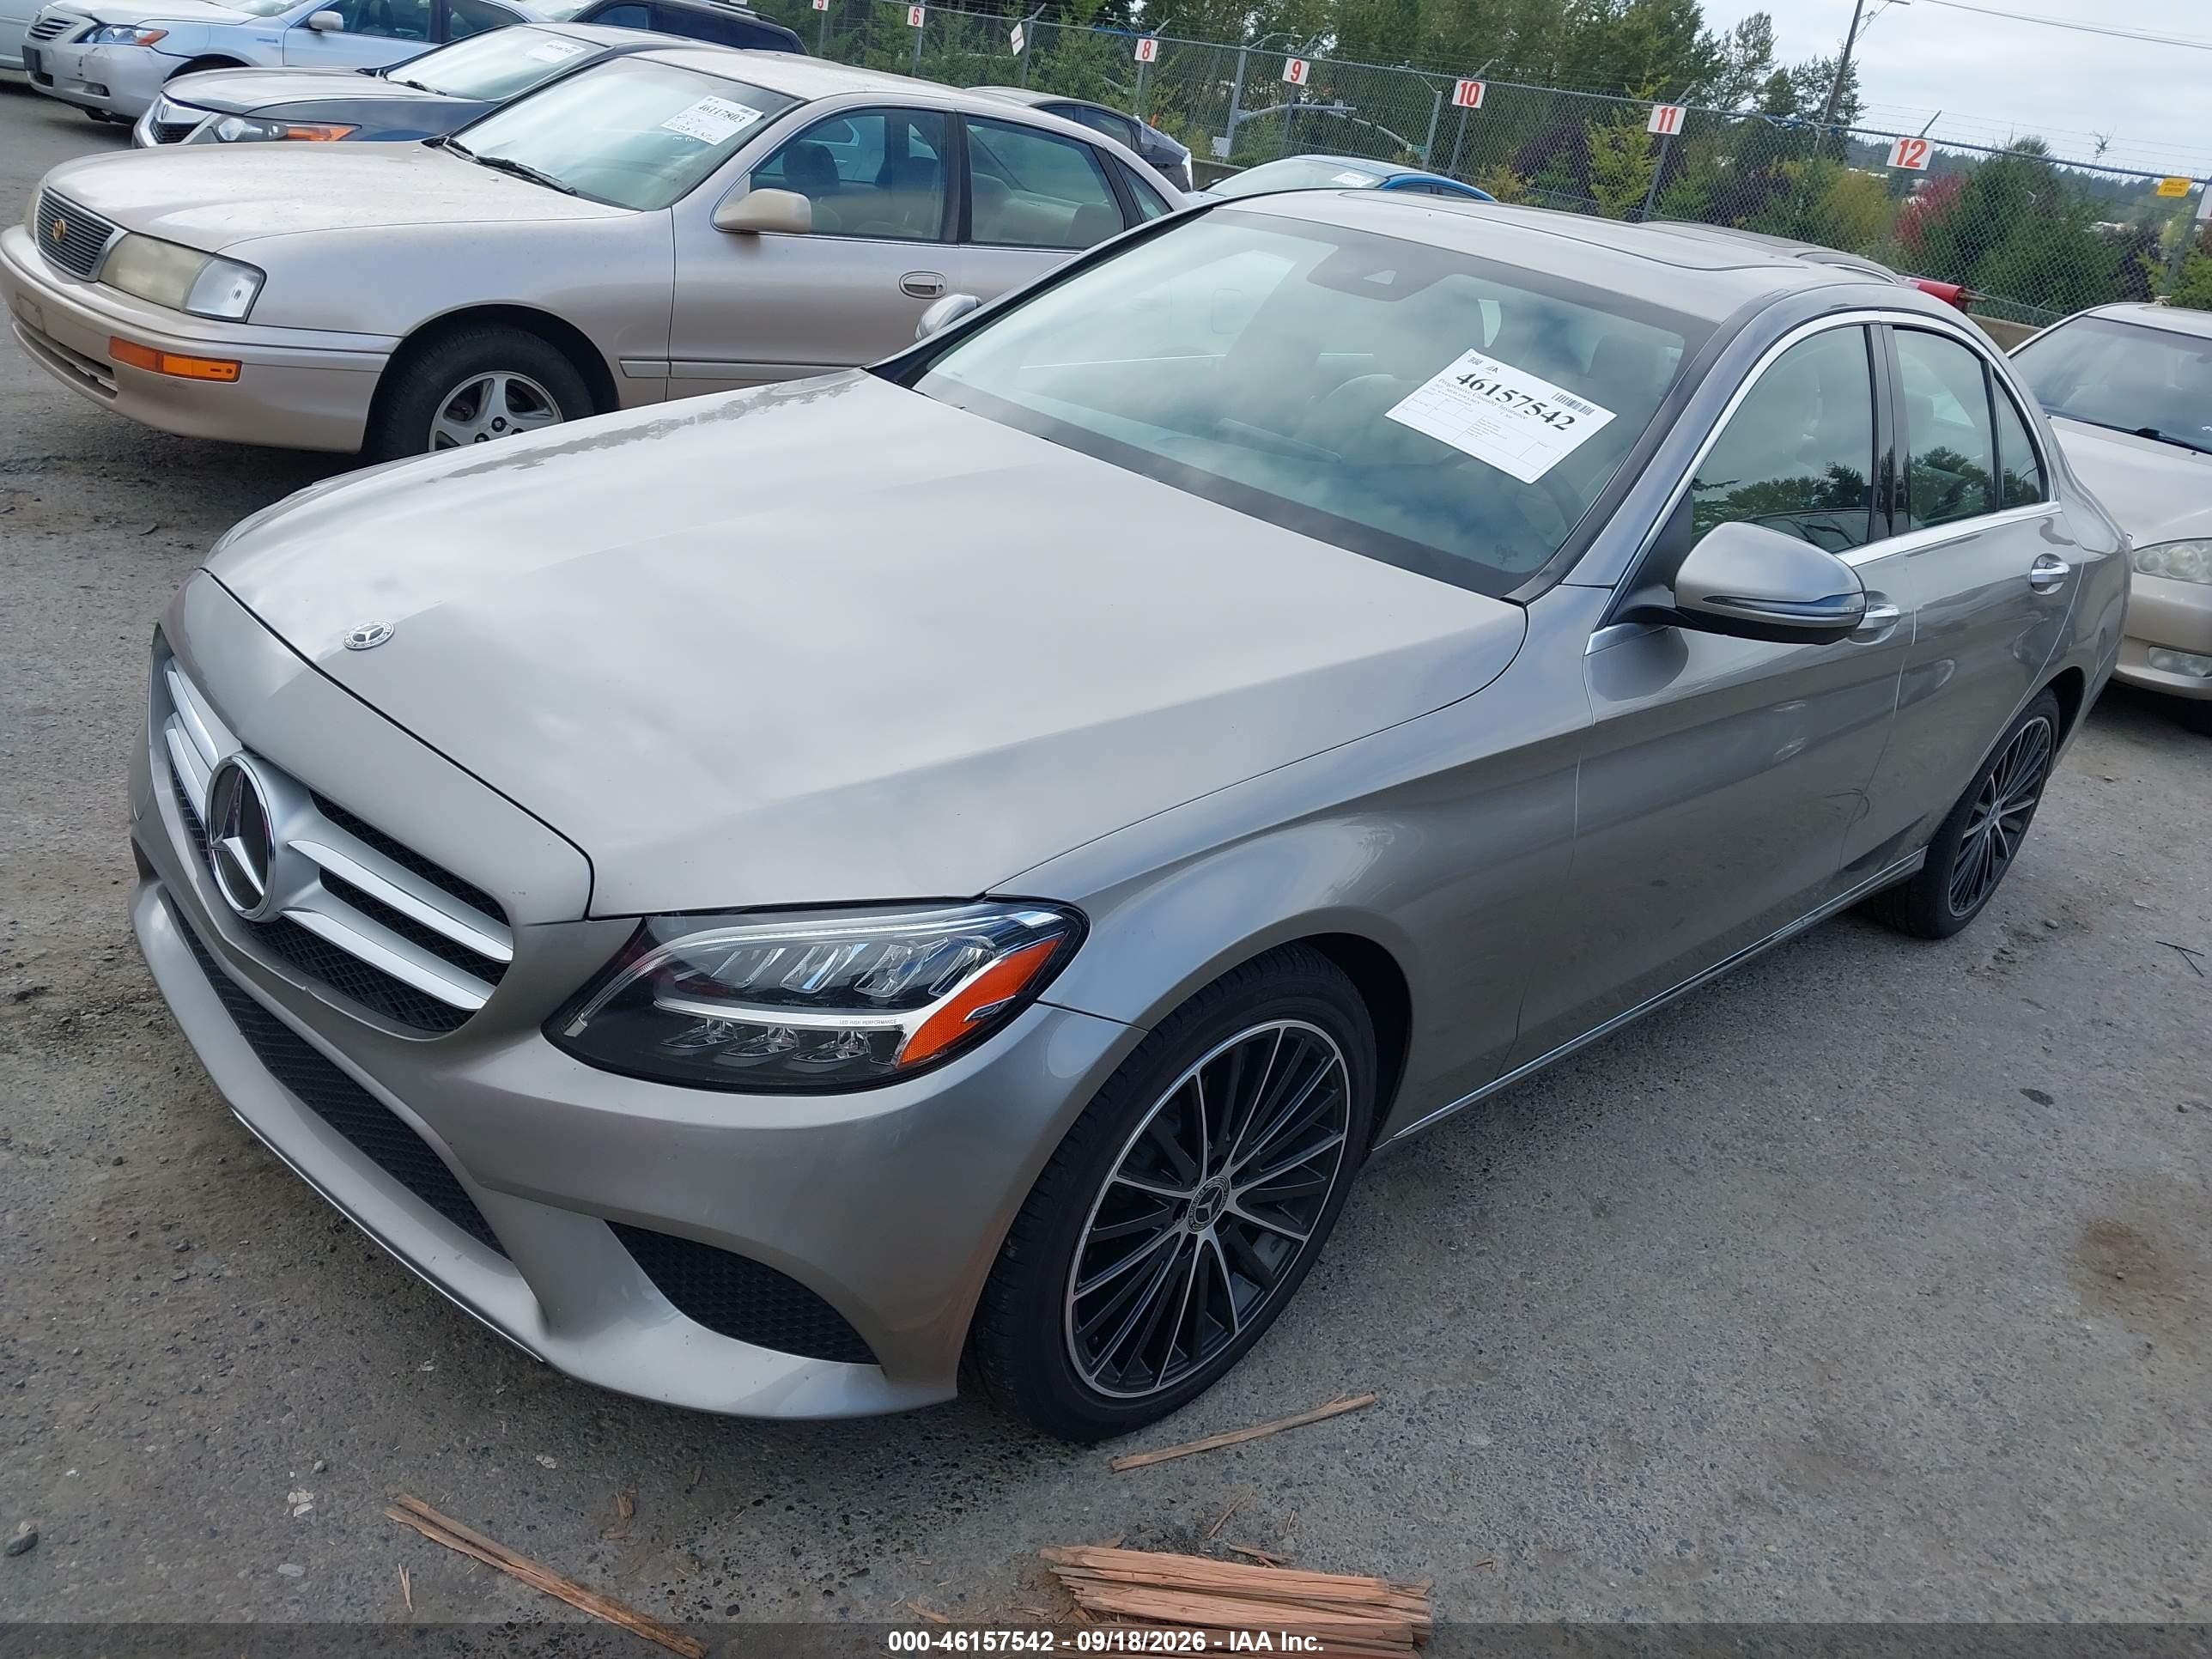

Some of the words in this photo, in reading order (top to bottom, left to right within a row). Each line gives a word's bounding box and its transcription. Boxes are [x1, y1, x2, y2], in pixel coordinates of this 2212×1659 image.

[913, 8, 921, 26] 6
[1141, 40, 1152, 60] 8
[1291, 60, 1302, 82] 9
[1459, 82, 1481, 106] 10
[1657, 106, 1678, 132] 11
[1896, 139, 1927, 168] 12
[1455, 373, 1576, 431] 46157542
